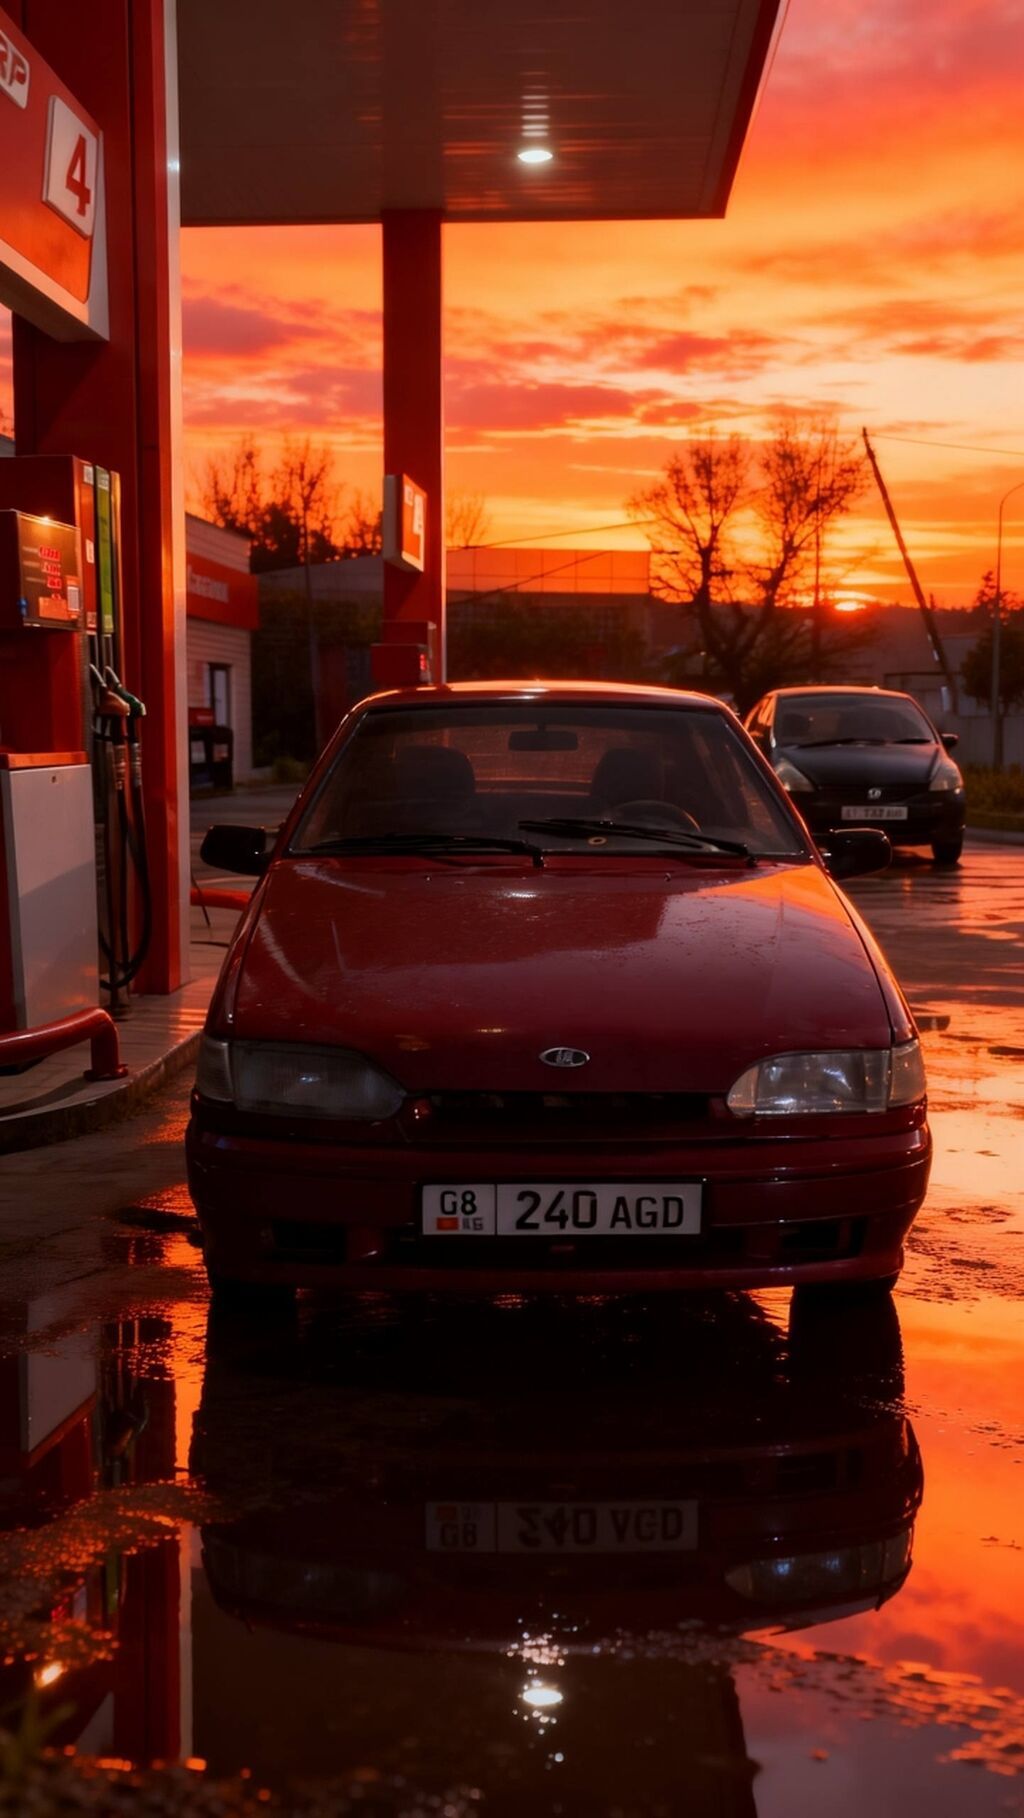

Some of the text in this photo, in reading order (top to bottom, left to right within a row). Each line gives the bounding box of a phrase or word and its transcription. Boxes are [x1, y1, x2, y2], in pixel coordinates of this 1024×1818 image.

[66, 134, 91, 217] 4
[515, 1190, 597, 1230] 240
[609, 1196, 684, 1229] AGD
